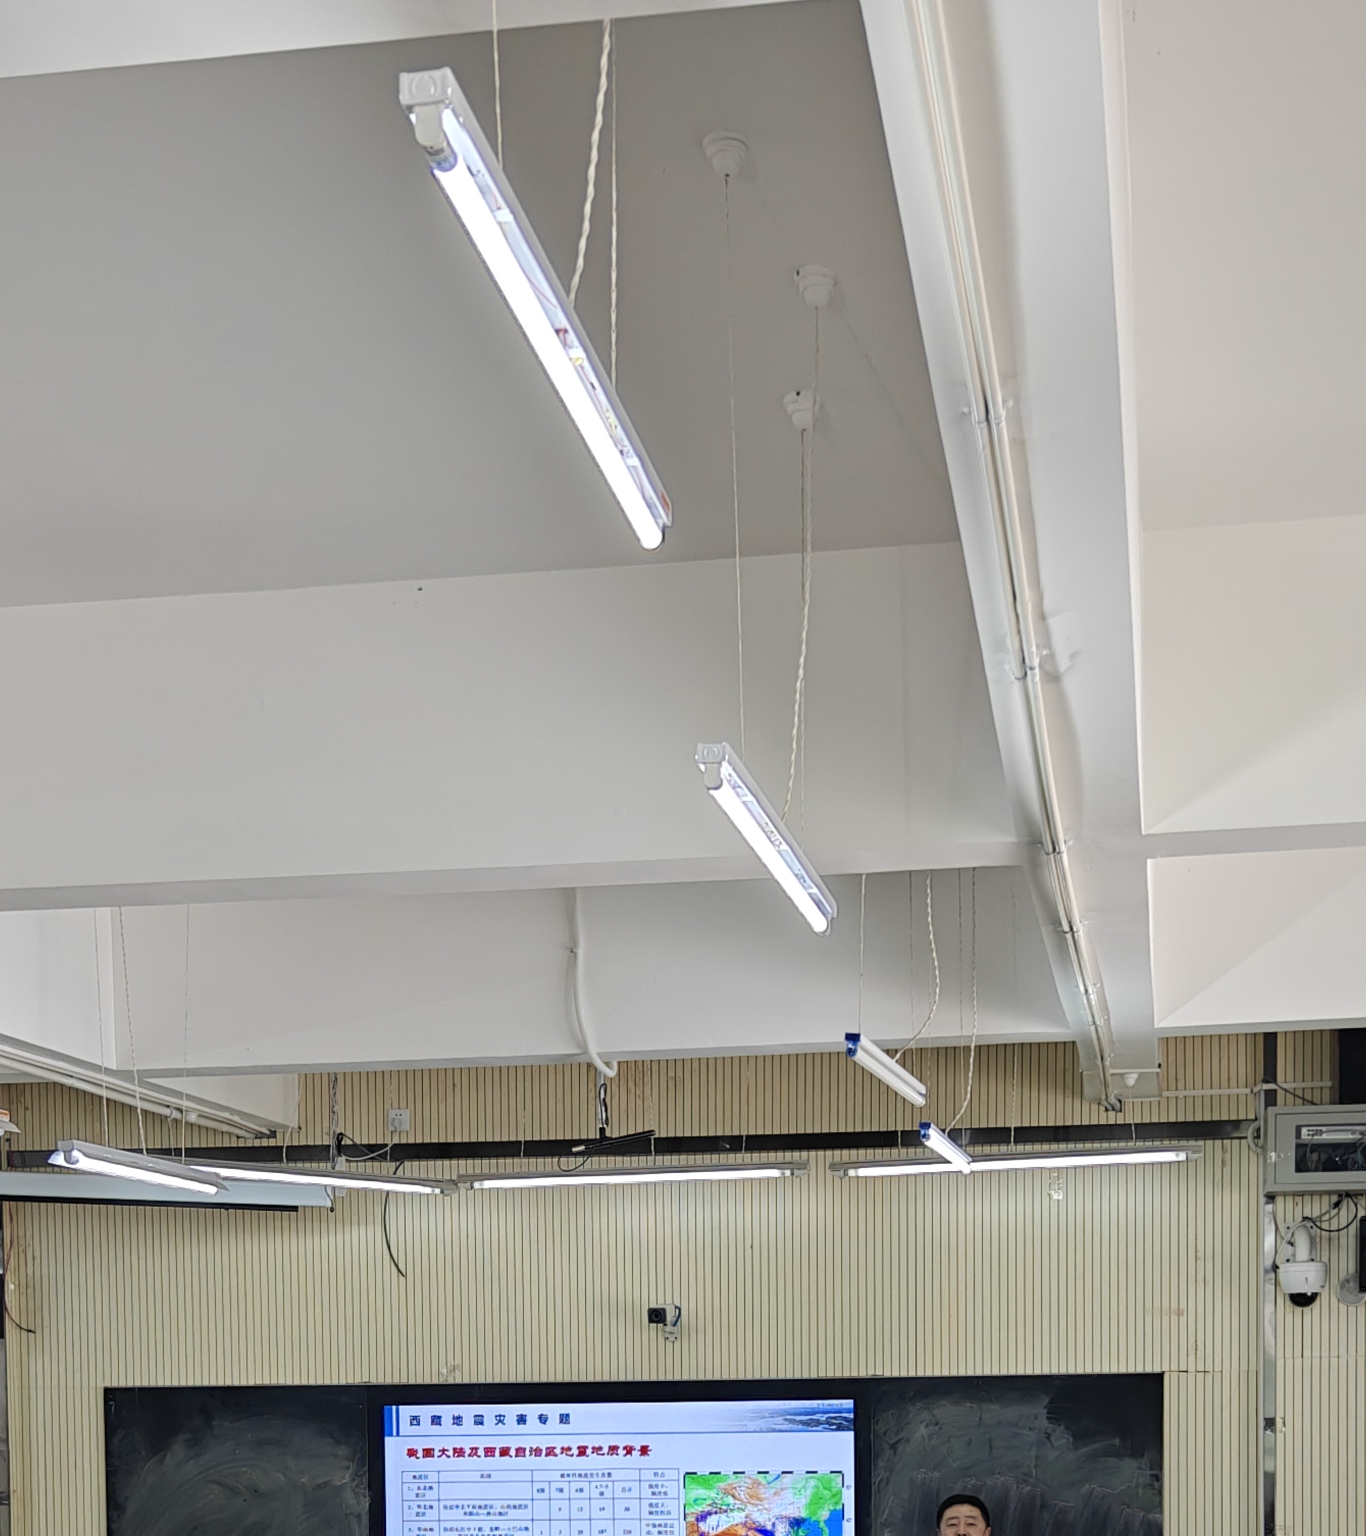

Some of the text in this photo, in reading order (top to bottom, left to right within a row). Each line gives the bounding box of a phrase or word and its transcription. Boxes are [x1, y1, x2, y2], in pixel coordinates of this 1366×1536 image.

[409, 1413, 571, 1427] 西藏地震灾害专题
[406, 1444, 652, 1460] 我国大陆及西藏自治区地震地质背景
